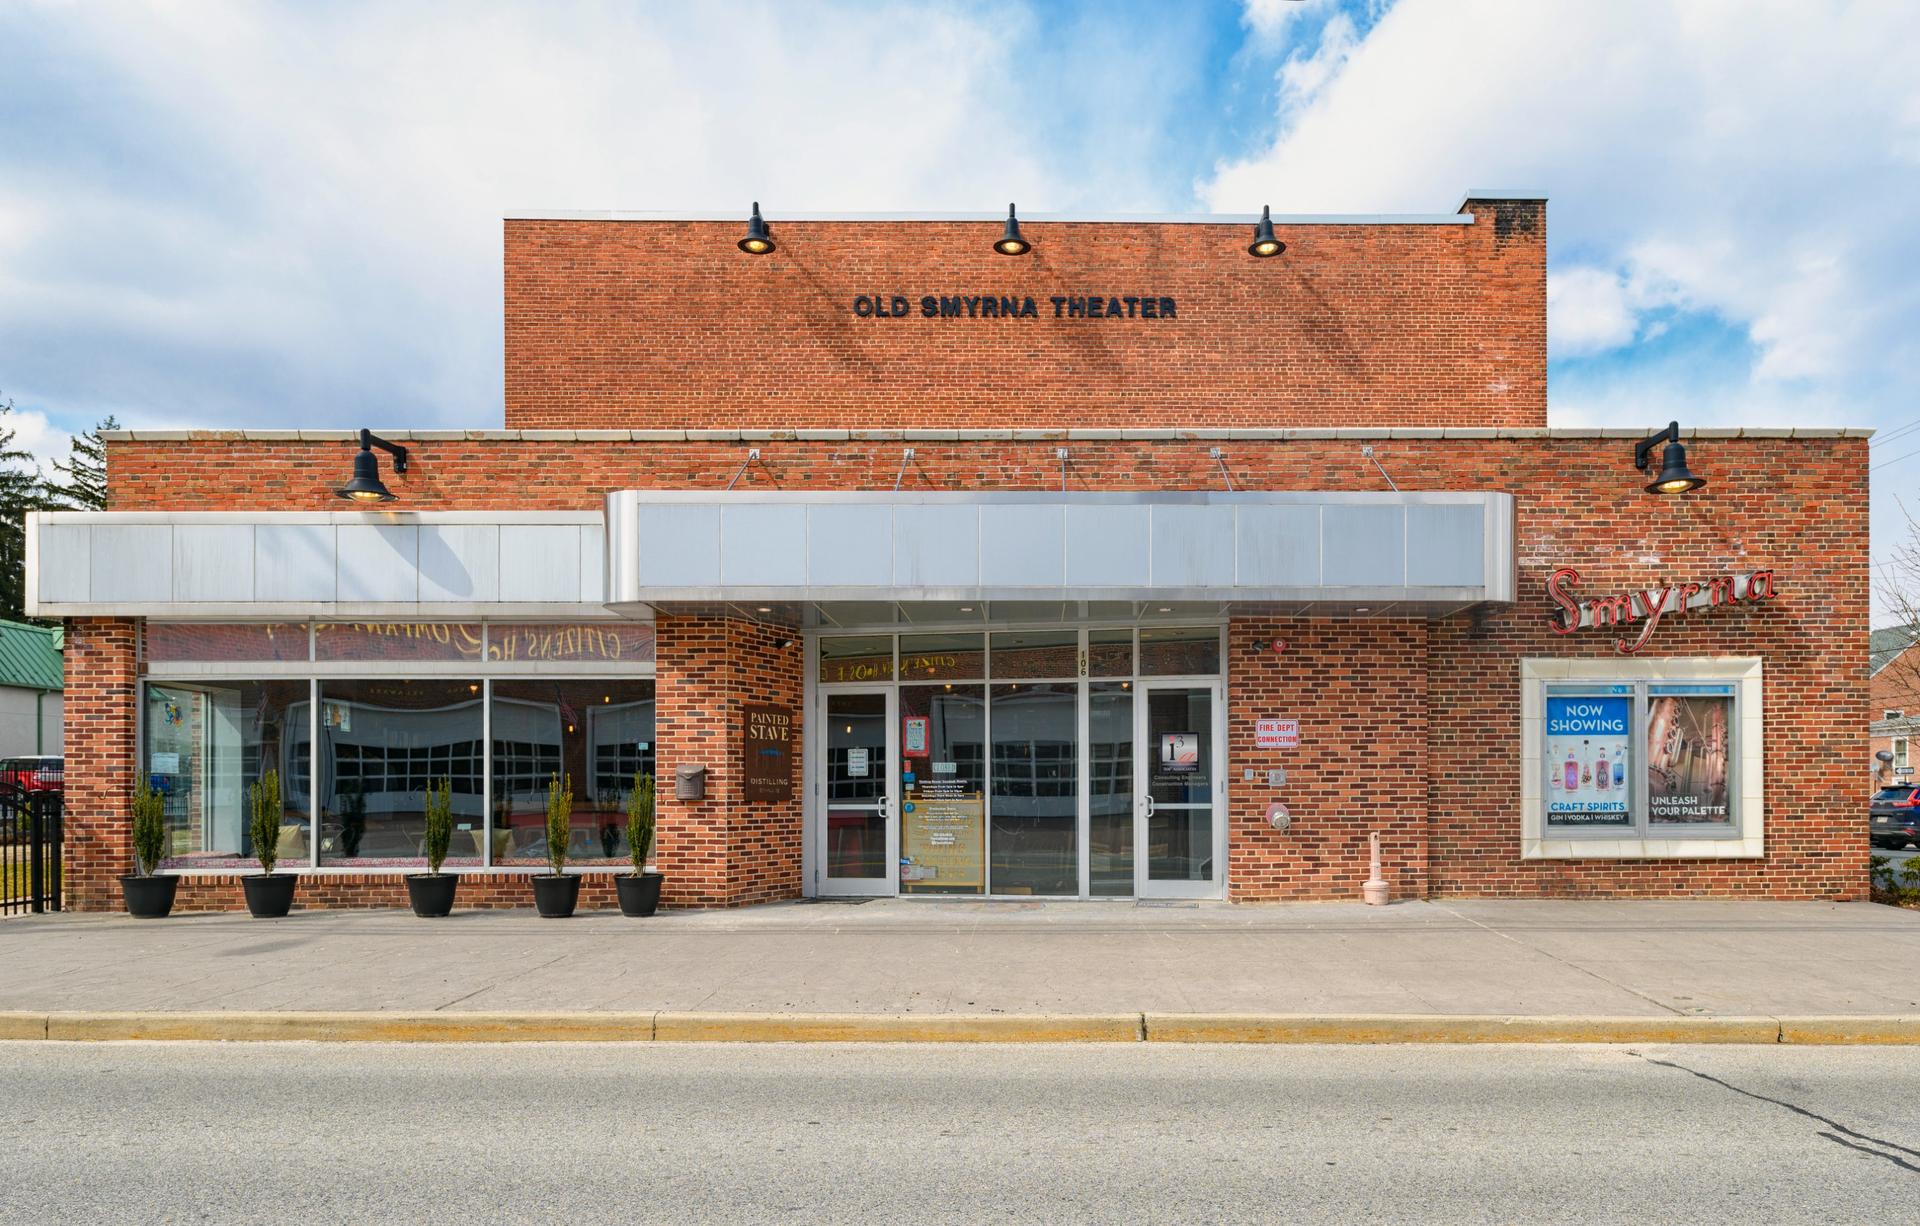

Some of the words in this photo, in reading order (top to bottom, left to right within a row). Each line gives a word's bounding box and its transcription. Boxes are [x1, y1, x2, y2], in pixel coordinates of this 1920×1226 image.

[853, 295, 909, 318] OLD
[921, 296, 1038, 318] SMYRNA
[1050, 296, 1177, 318] THEATER
[1547, 568, 1778, 654] Smyrna
[1566, 705, 1604, 717] NOW
[751, 712, 789, 725] PAINTED
[1550, 719, 1624, 732] SHOWING
[750, 724, 789, 741] STAVE
[1551, 802, 1584, 811] CRAFT
[1587, 802, 1625, 811] SPIRITS
[1651, 796, 1698, 805] UNLEASH
[1651, 806, 1680, 815] YOUR
[1682, 806, 1726, 815] PALETTE
